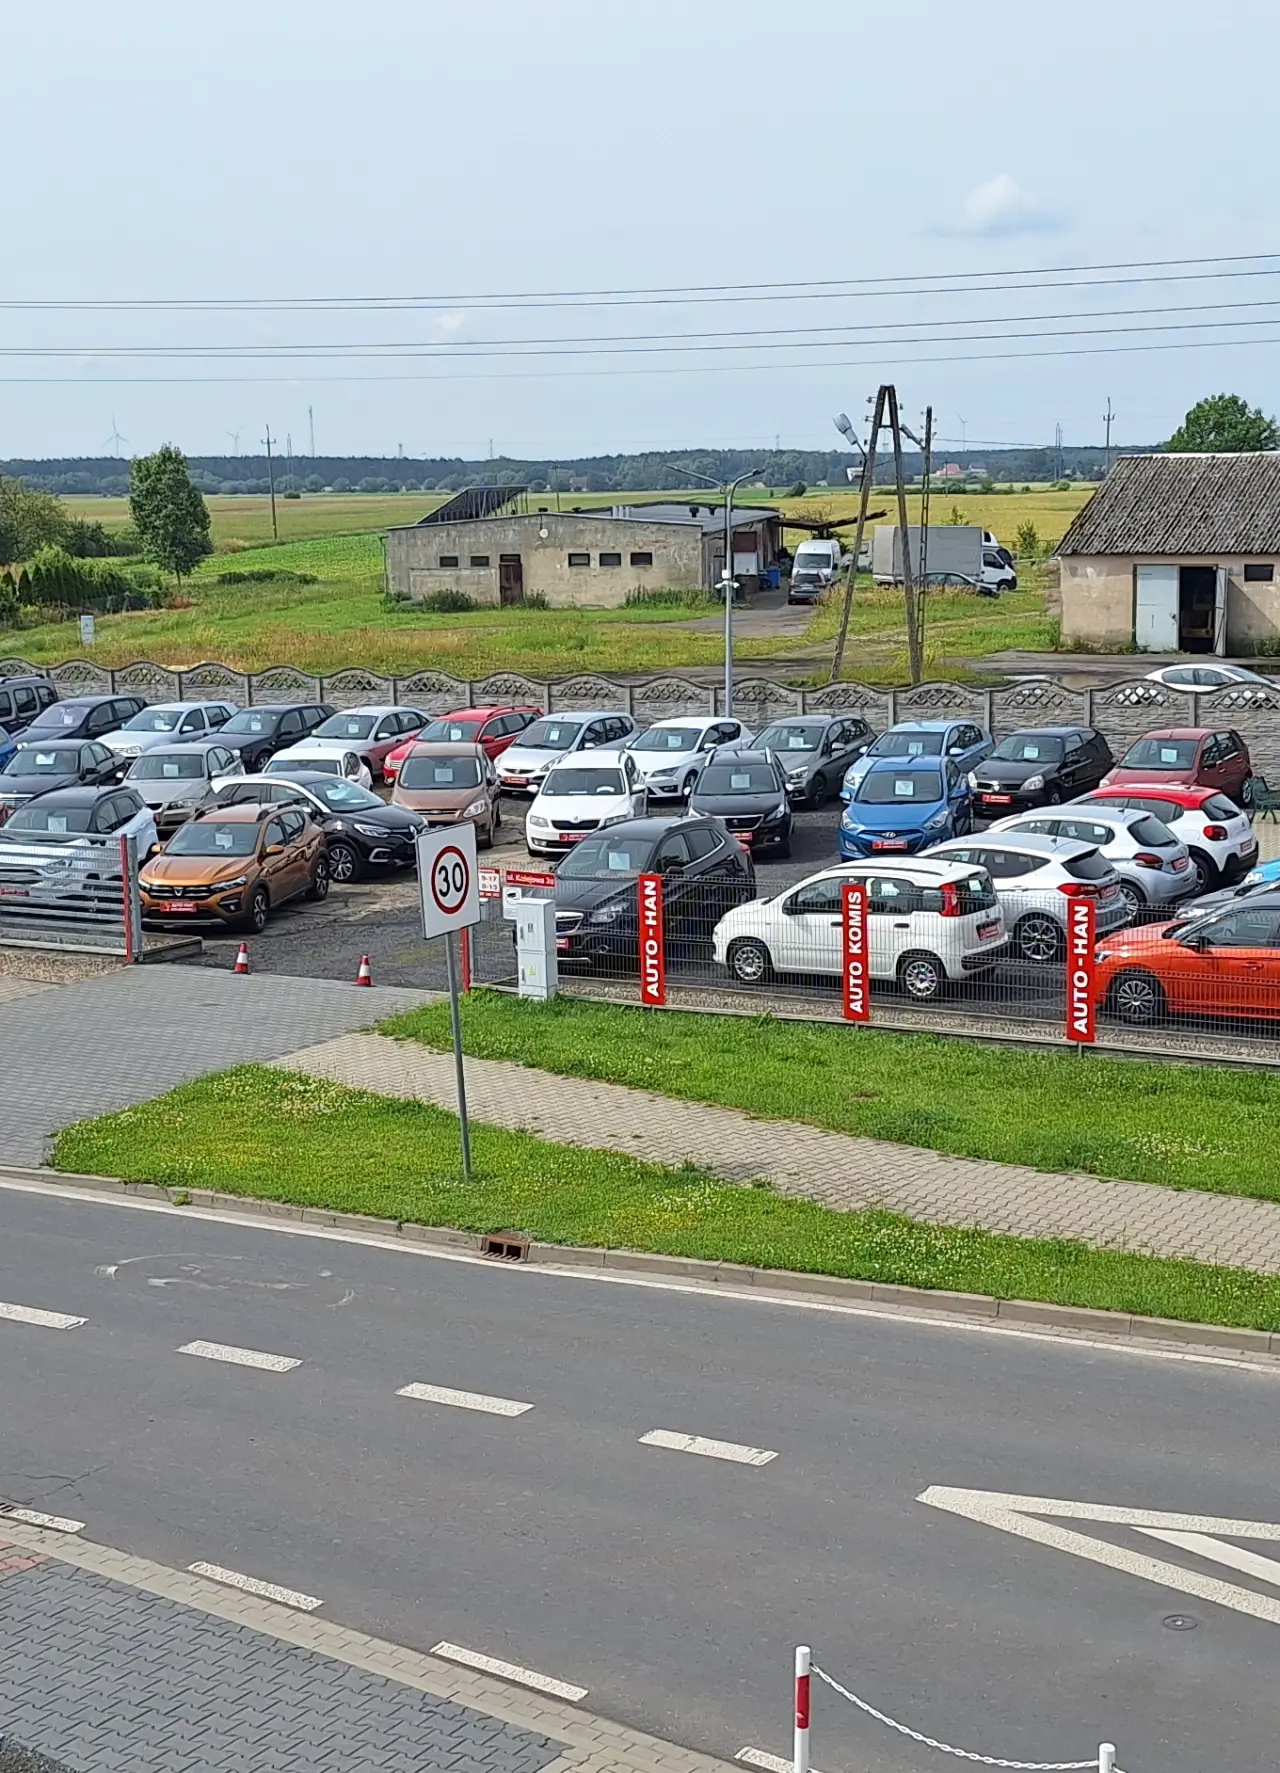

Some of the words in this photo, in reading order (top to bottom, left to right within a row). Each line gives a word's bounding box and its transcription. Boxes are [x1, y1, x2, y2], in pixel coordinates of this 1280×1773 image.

[438, 862, 464, 898] 30
[848, 891, 862, 955] KOMIS
[849, 961, 863, 1014] AUTO
